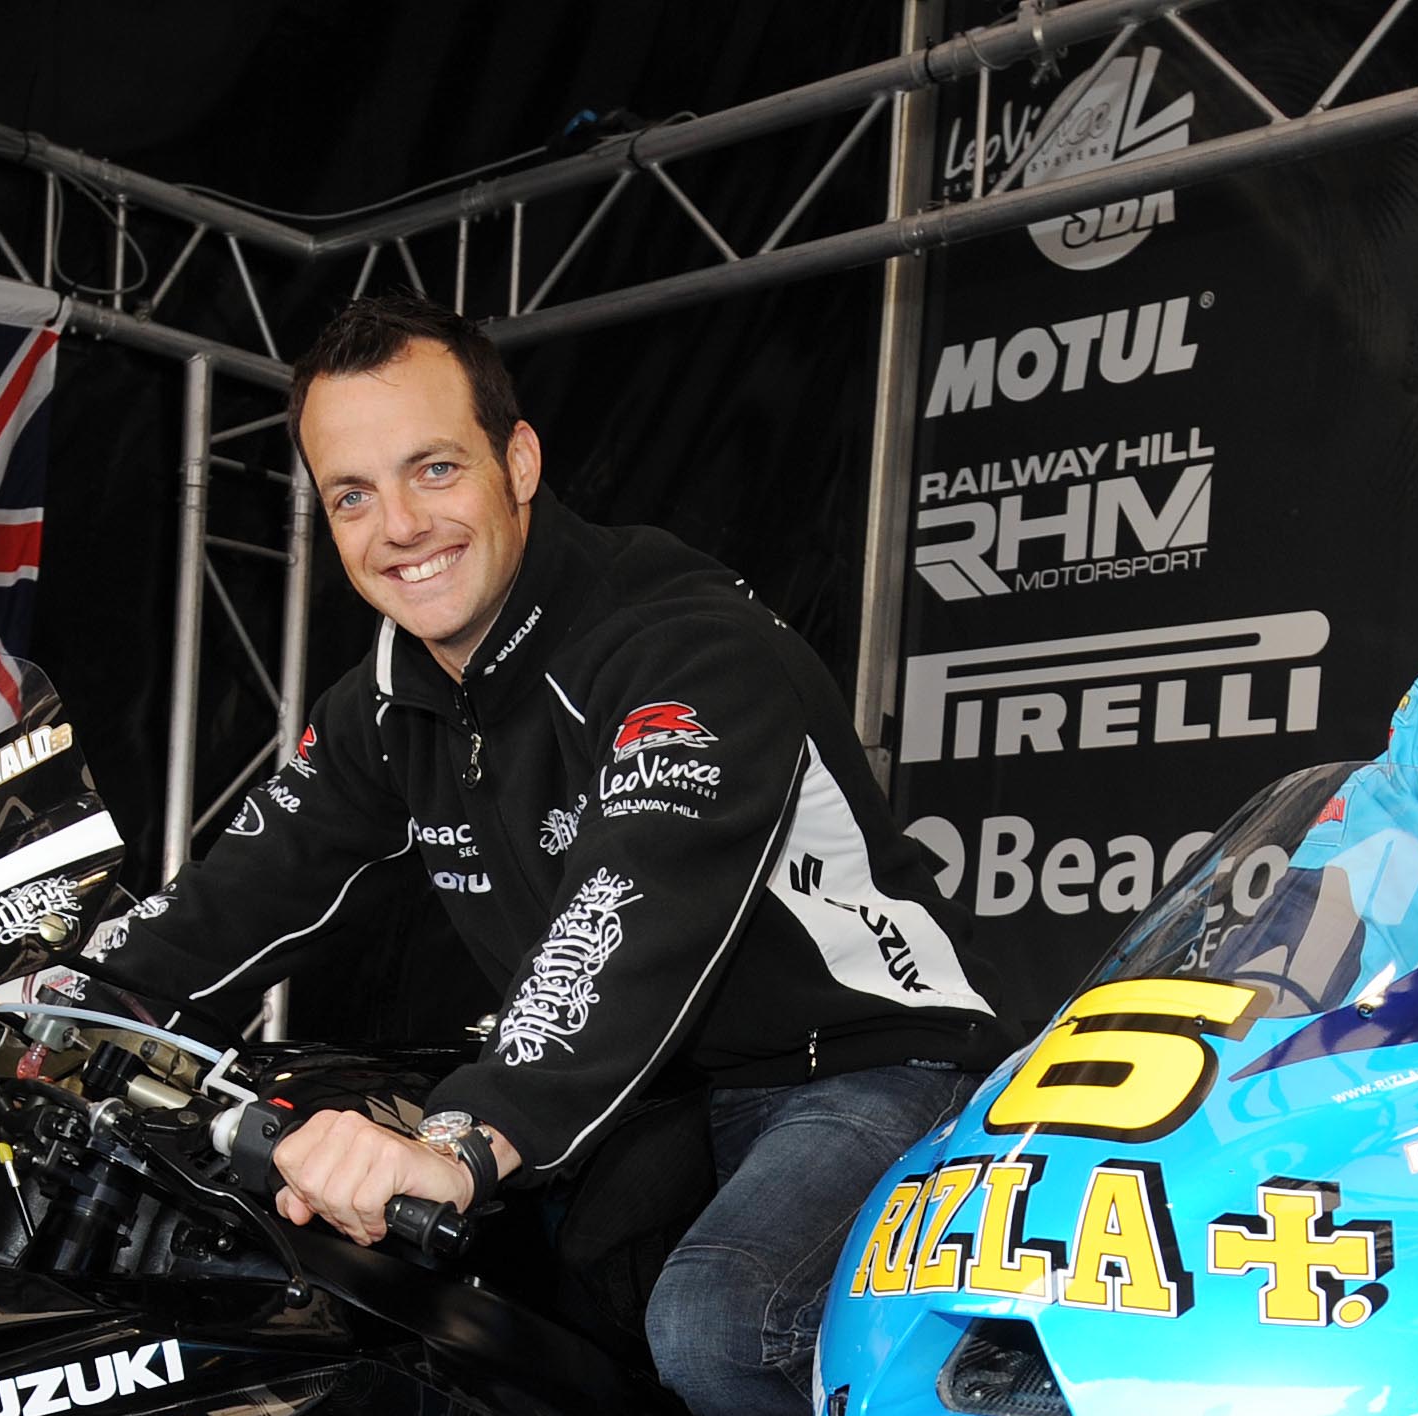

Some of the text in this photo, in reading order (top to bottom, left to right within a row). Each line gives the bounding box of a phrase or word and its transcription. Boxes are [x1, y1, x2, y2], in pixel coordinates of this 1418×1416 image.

[925, 296, 1198, 418] MOTUL
[919, 427, 1215, 503] RAILWAY HILL
[915, 463, 1213, 600] RHM
[1015, 548, 1208, 593] MOTORSPORT
[495, 605, 543, 663] SUZUKI
[900, 610, 1330, 764] PIRELLI
[599, 751, 721, 801] LeoVince
